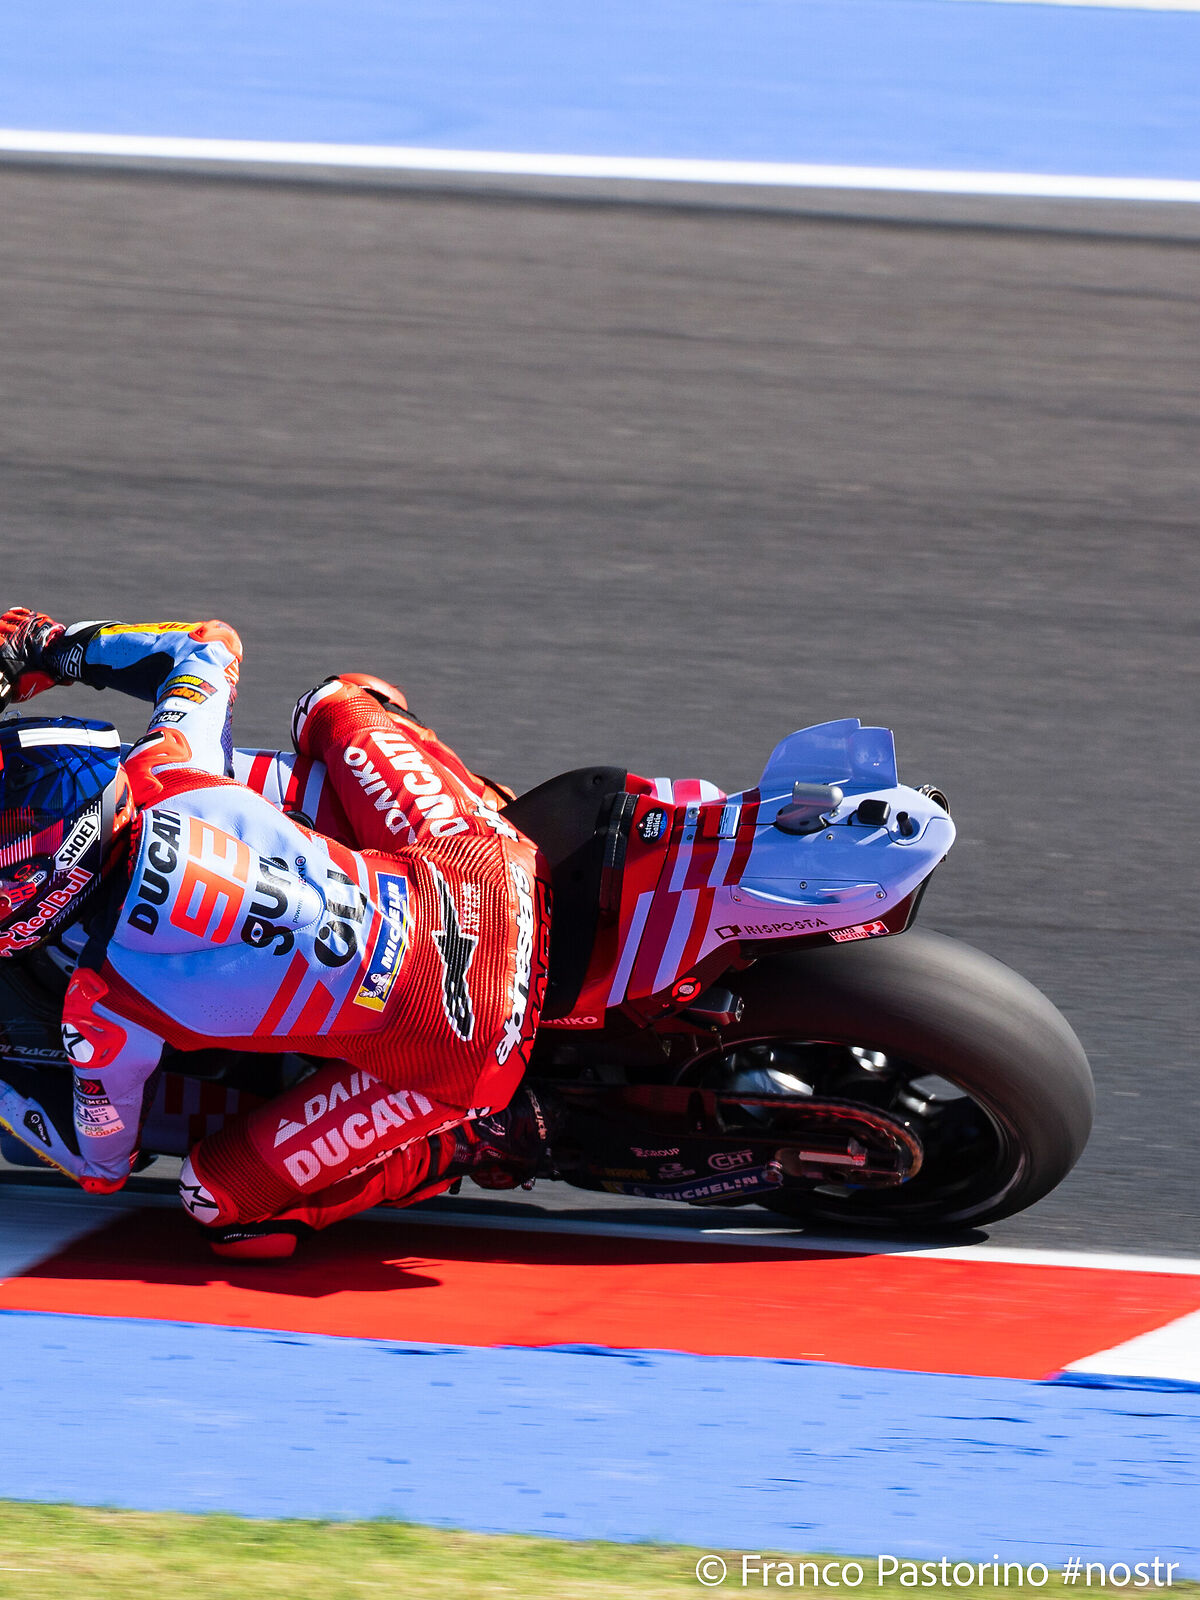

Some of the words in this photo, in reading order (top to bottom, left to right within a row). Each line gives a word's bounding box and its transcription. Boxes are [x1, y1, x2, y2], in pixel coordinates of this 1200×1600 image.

[344, 746, 409, 835] DAIKO
[370, 731, 469, 837] DUCATI
[58, 820, 97, 866] SHOEI
[643, 812, 655, 838] Estrella
[650, 813, 662, 837] Galicia
[9, 901, 54, 937] Red
[45, 866, 94, 909] Bull
[169, 816, 250, 944] 93
[744, 918, 828, 935] RISPOSTA
[834, 931, 868, 942] racing
[304, 1069, 382, 1126] DAIK
[283, 1091, 434, 1187] DUCATI
[654, 1176, 759, 1201] MICHELIN
